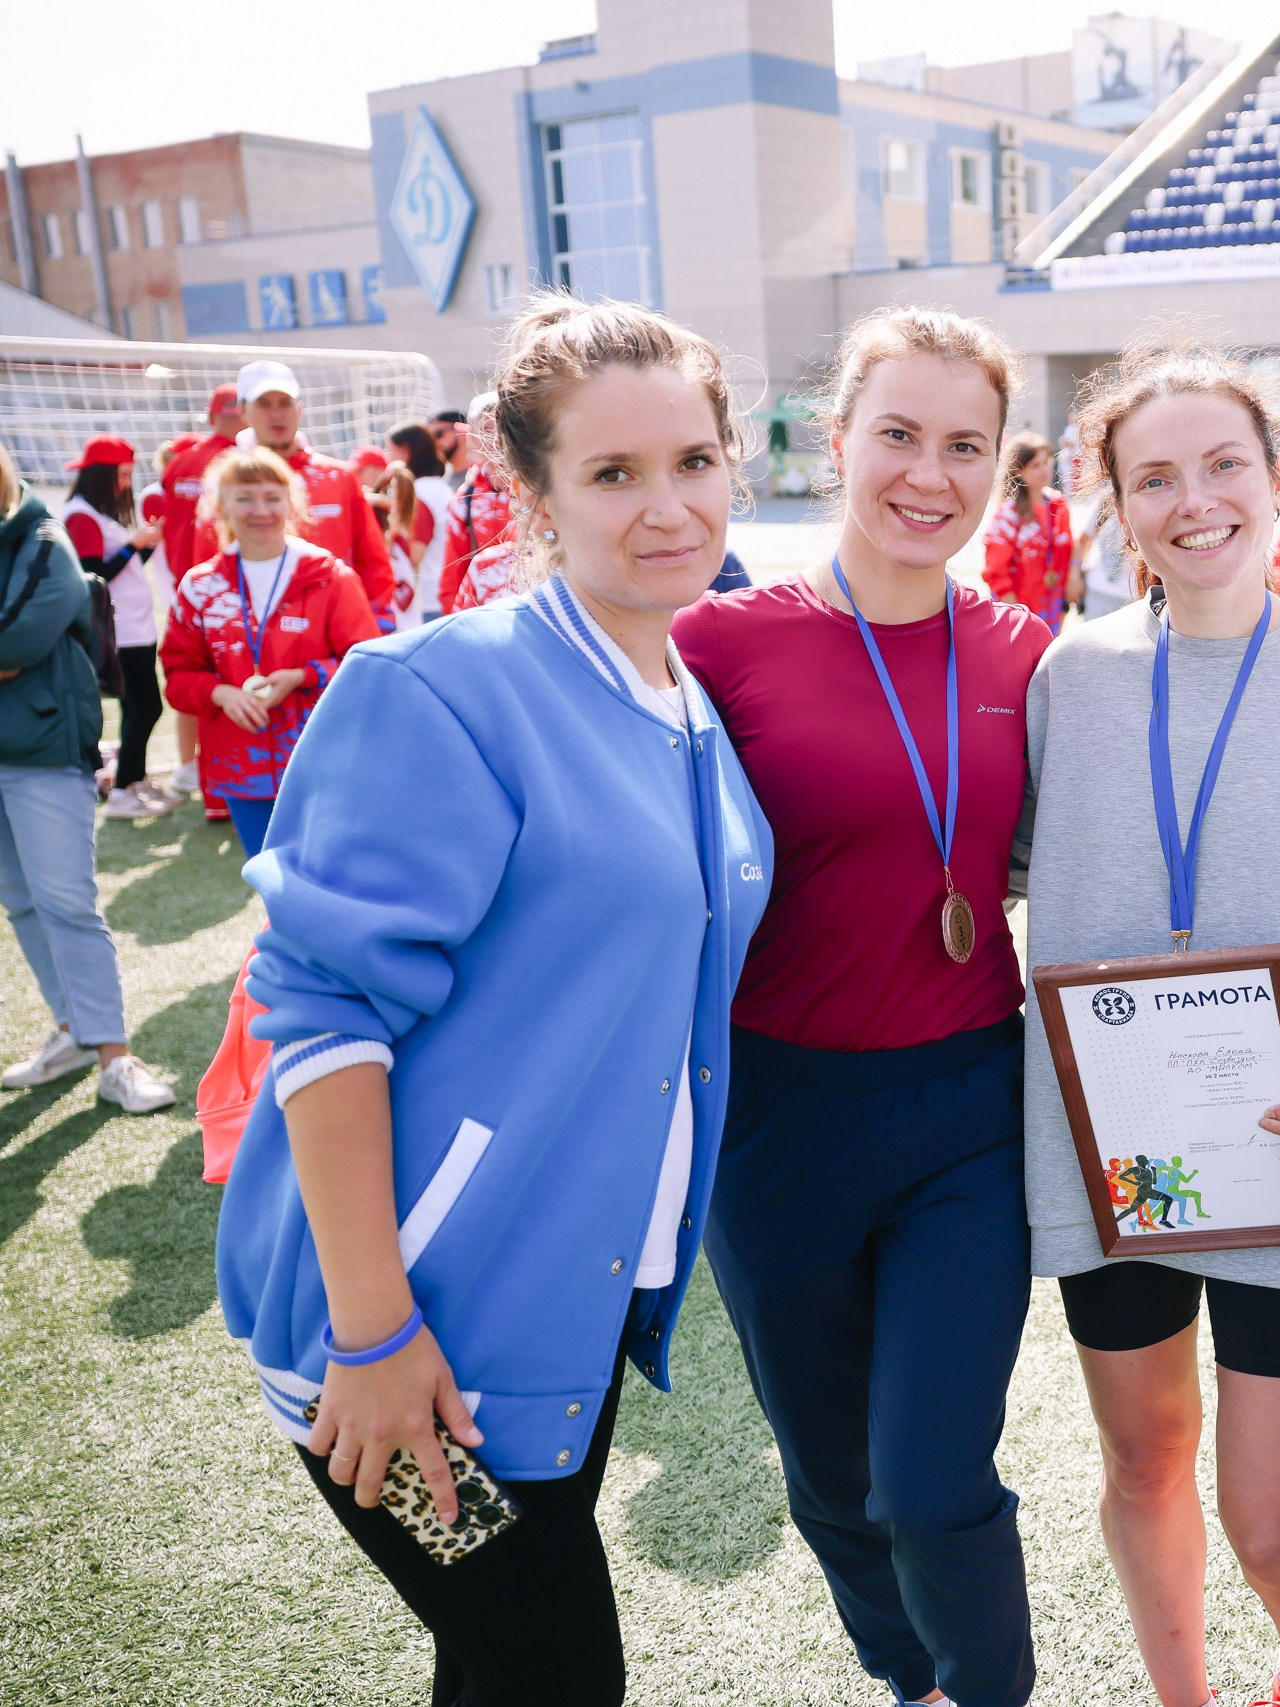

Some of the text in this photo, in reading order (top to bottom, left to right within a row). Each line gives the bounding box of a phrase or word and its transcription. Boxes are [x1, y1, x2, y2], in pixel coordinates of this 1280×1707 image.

[986, 706, 1016, 715] DEMIX
[1094, 988, 1131, 1003] КОМОС ГРУПП
[1154, 985, 1272, 1011] ГРАМОТА
[1097, 1010, 1135, 1025] СПАРТАКИАДА
